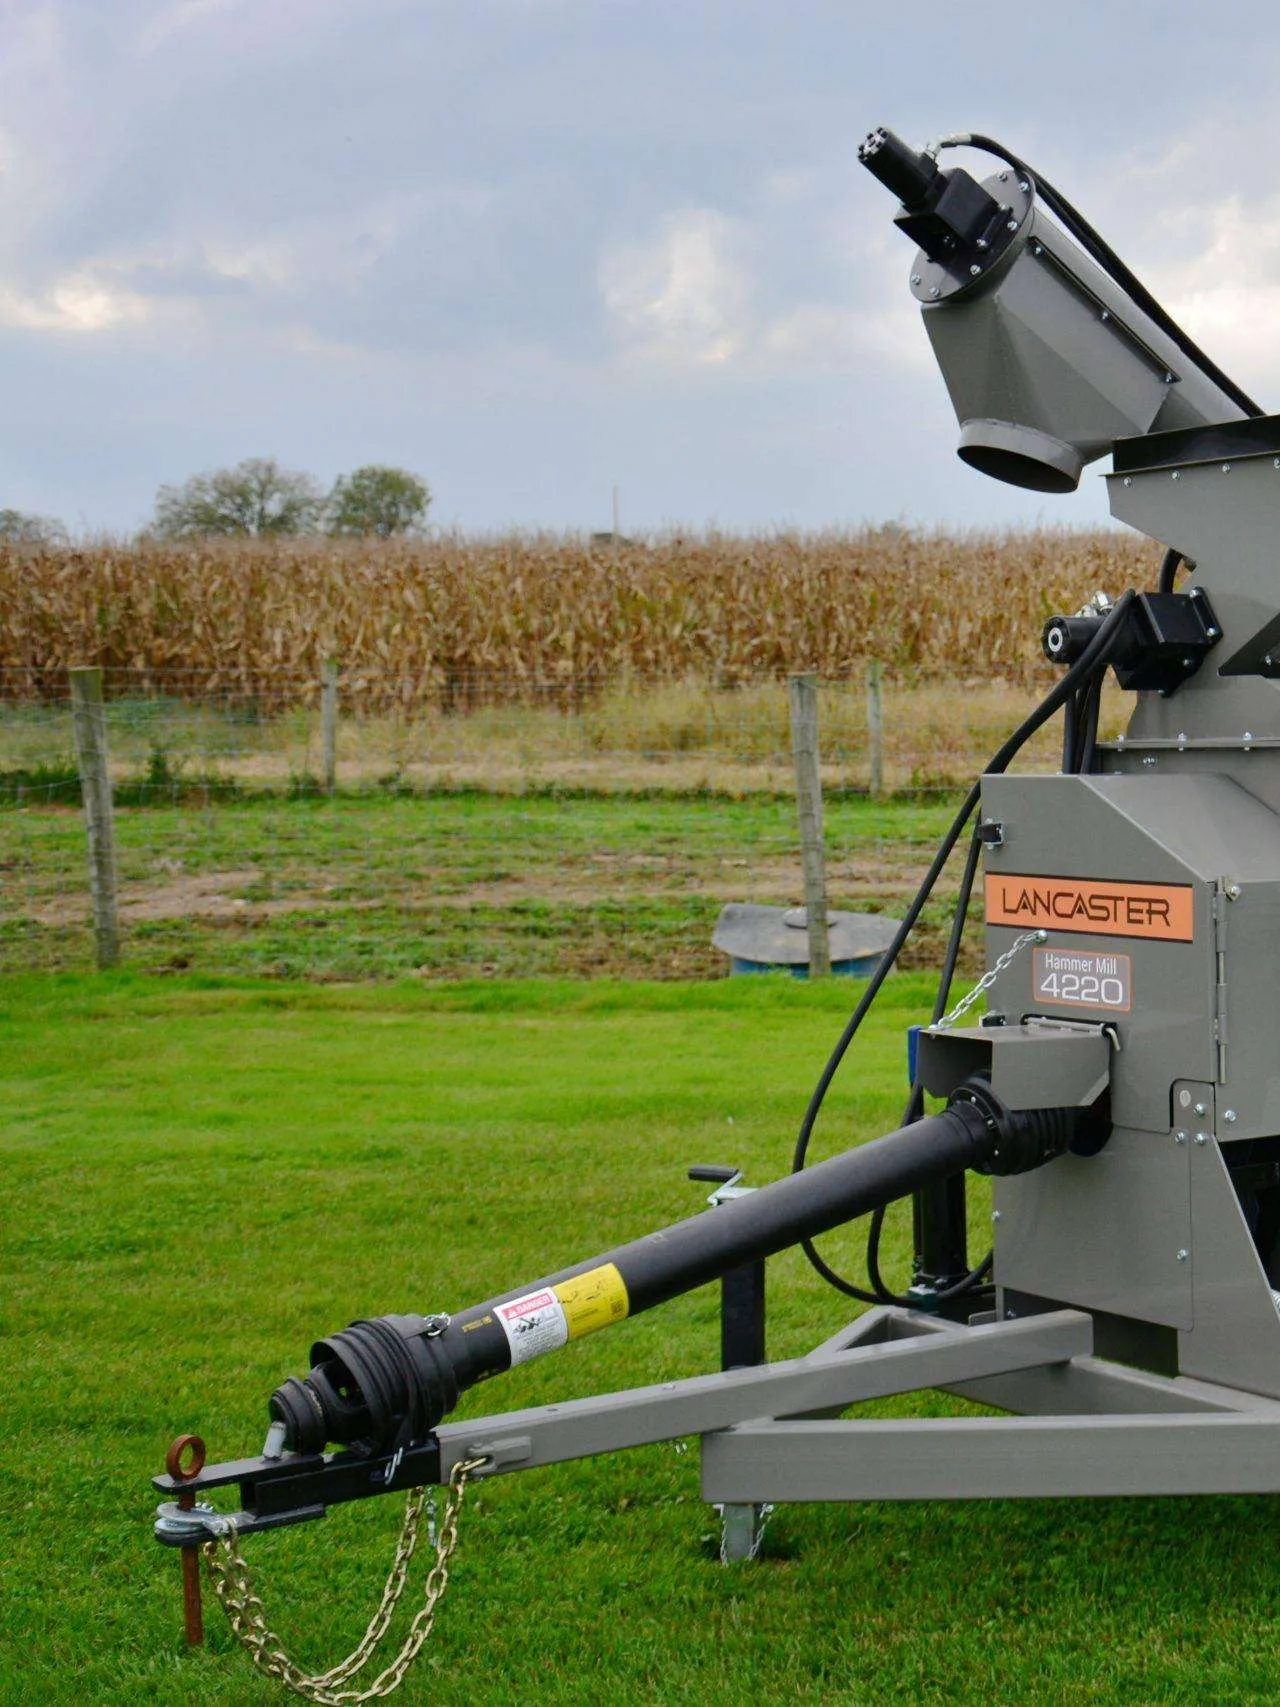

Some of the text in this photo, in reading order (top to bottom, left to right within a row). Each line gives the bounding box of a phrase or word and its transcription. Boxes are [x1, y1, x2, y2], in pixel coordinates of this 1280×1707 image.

[1002, 887, 1171, 927] LANCASTER
[1045, 953, 1117, 975] Hammer Mill
[1040, 973, 1123, 1005] 4220
